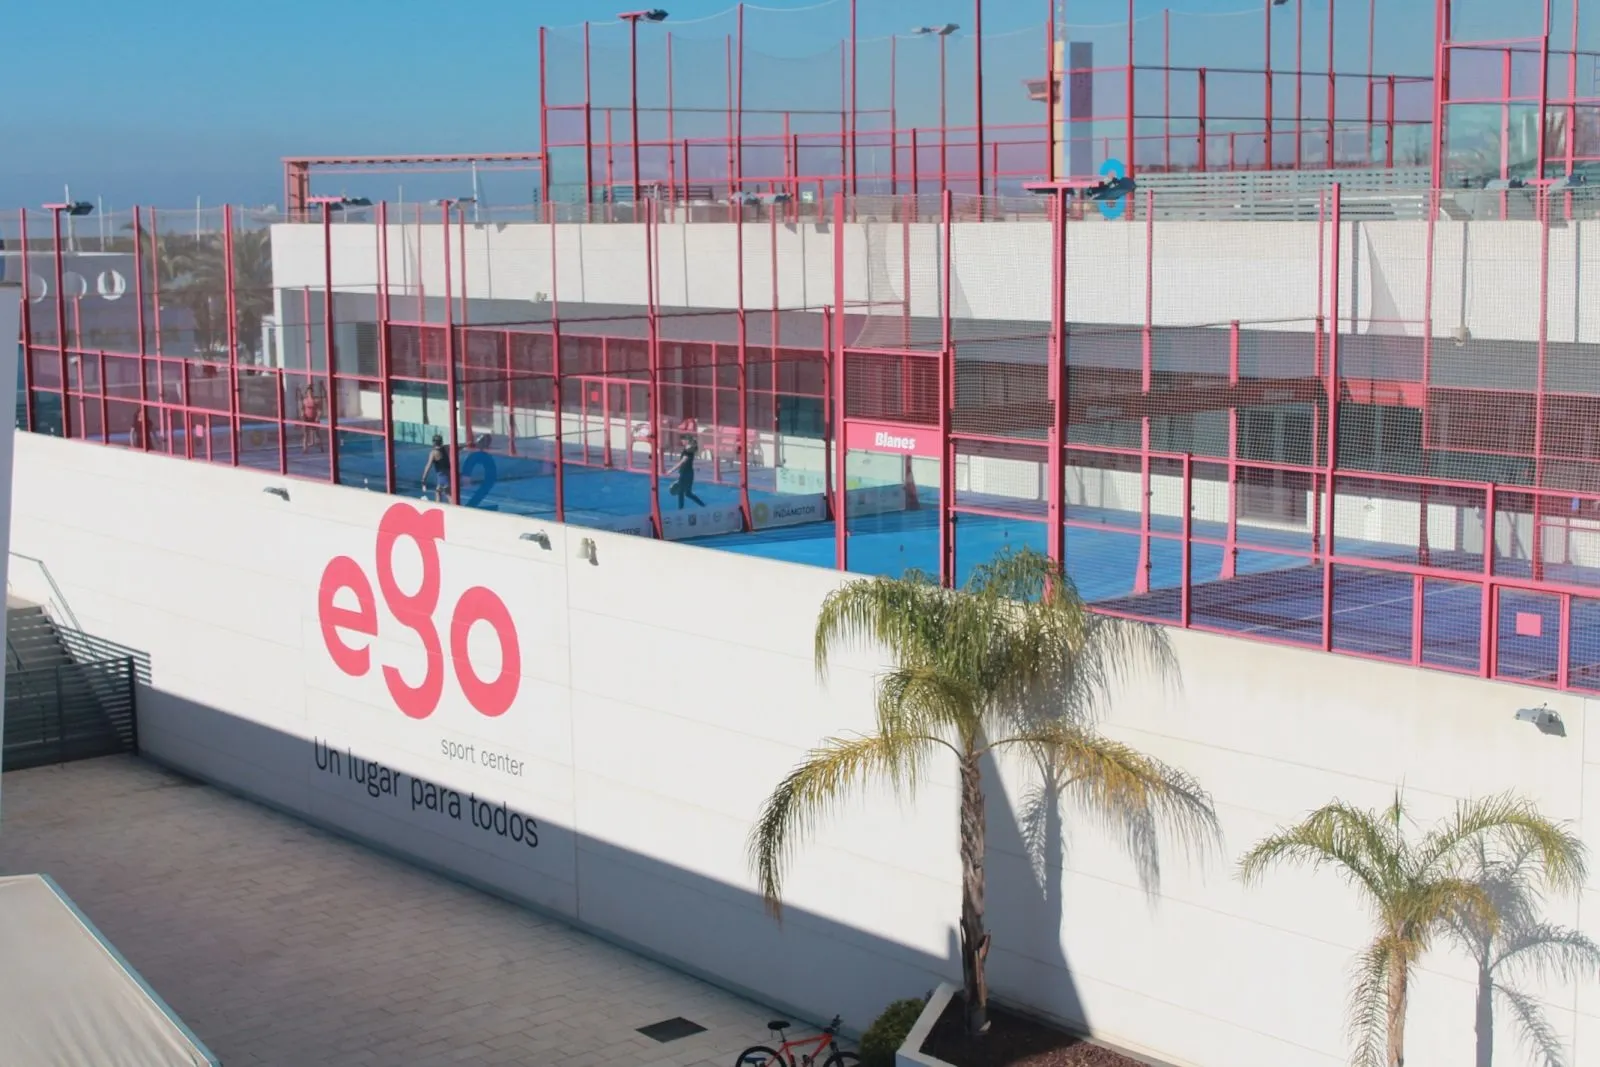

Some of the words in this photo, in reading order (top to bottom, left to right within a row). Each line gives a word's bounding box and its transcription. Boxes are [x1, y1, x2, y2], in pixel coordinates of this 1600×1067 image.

[874, 431, 916, 450] Blanes
[462, 451, 499, 511] 2
[318, 502, 521, 720] ego
[441, 737, 476, 765] sport
[481, 750, 525, 777] center
[314, 736, 341, 773] Un
[348, 747, 401, 798] lugar
[411, 775, 462, 821] para
[469, 792, 539, 849] todos
